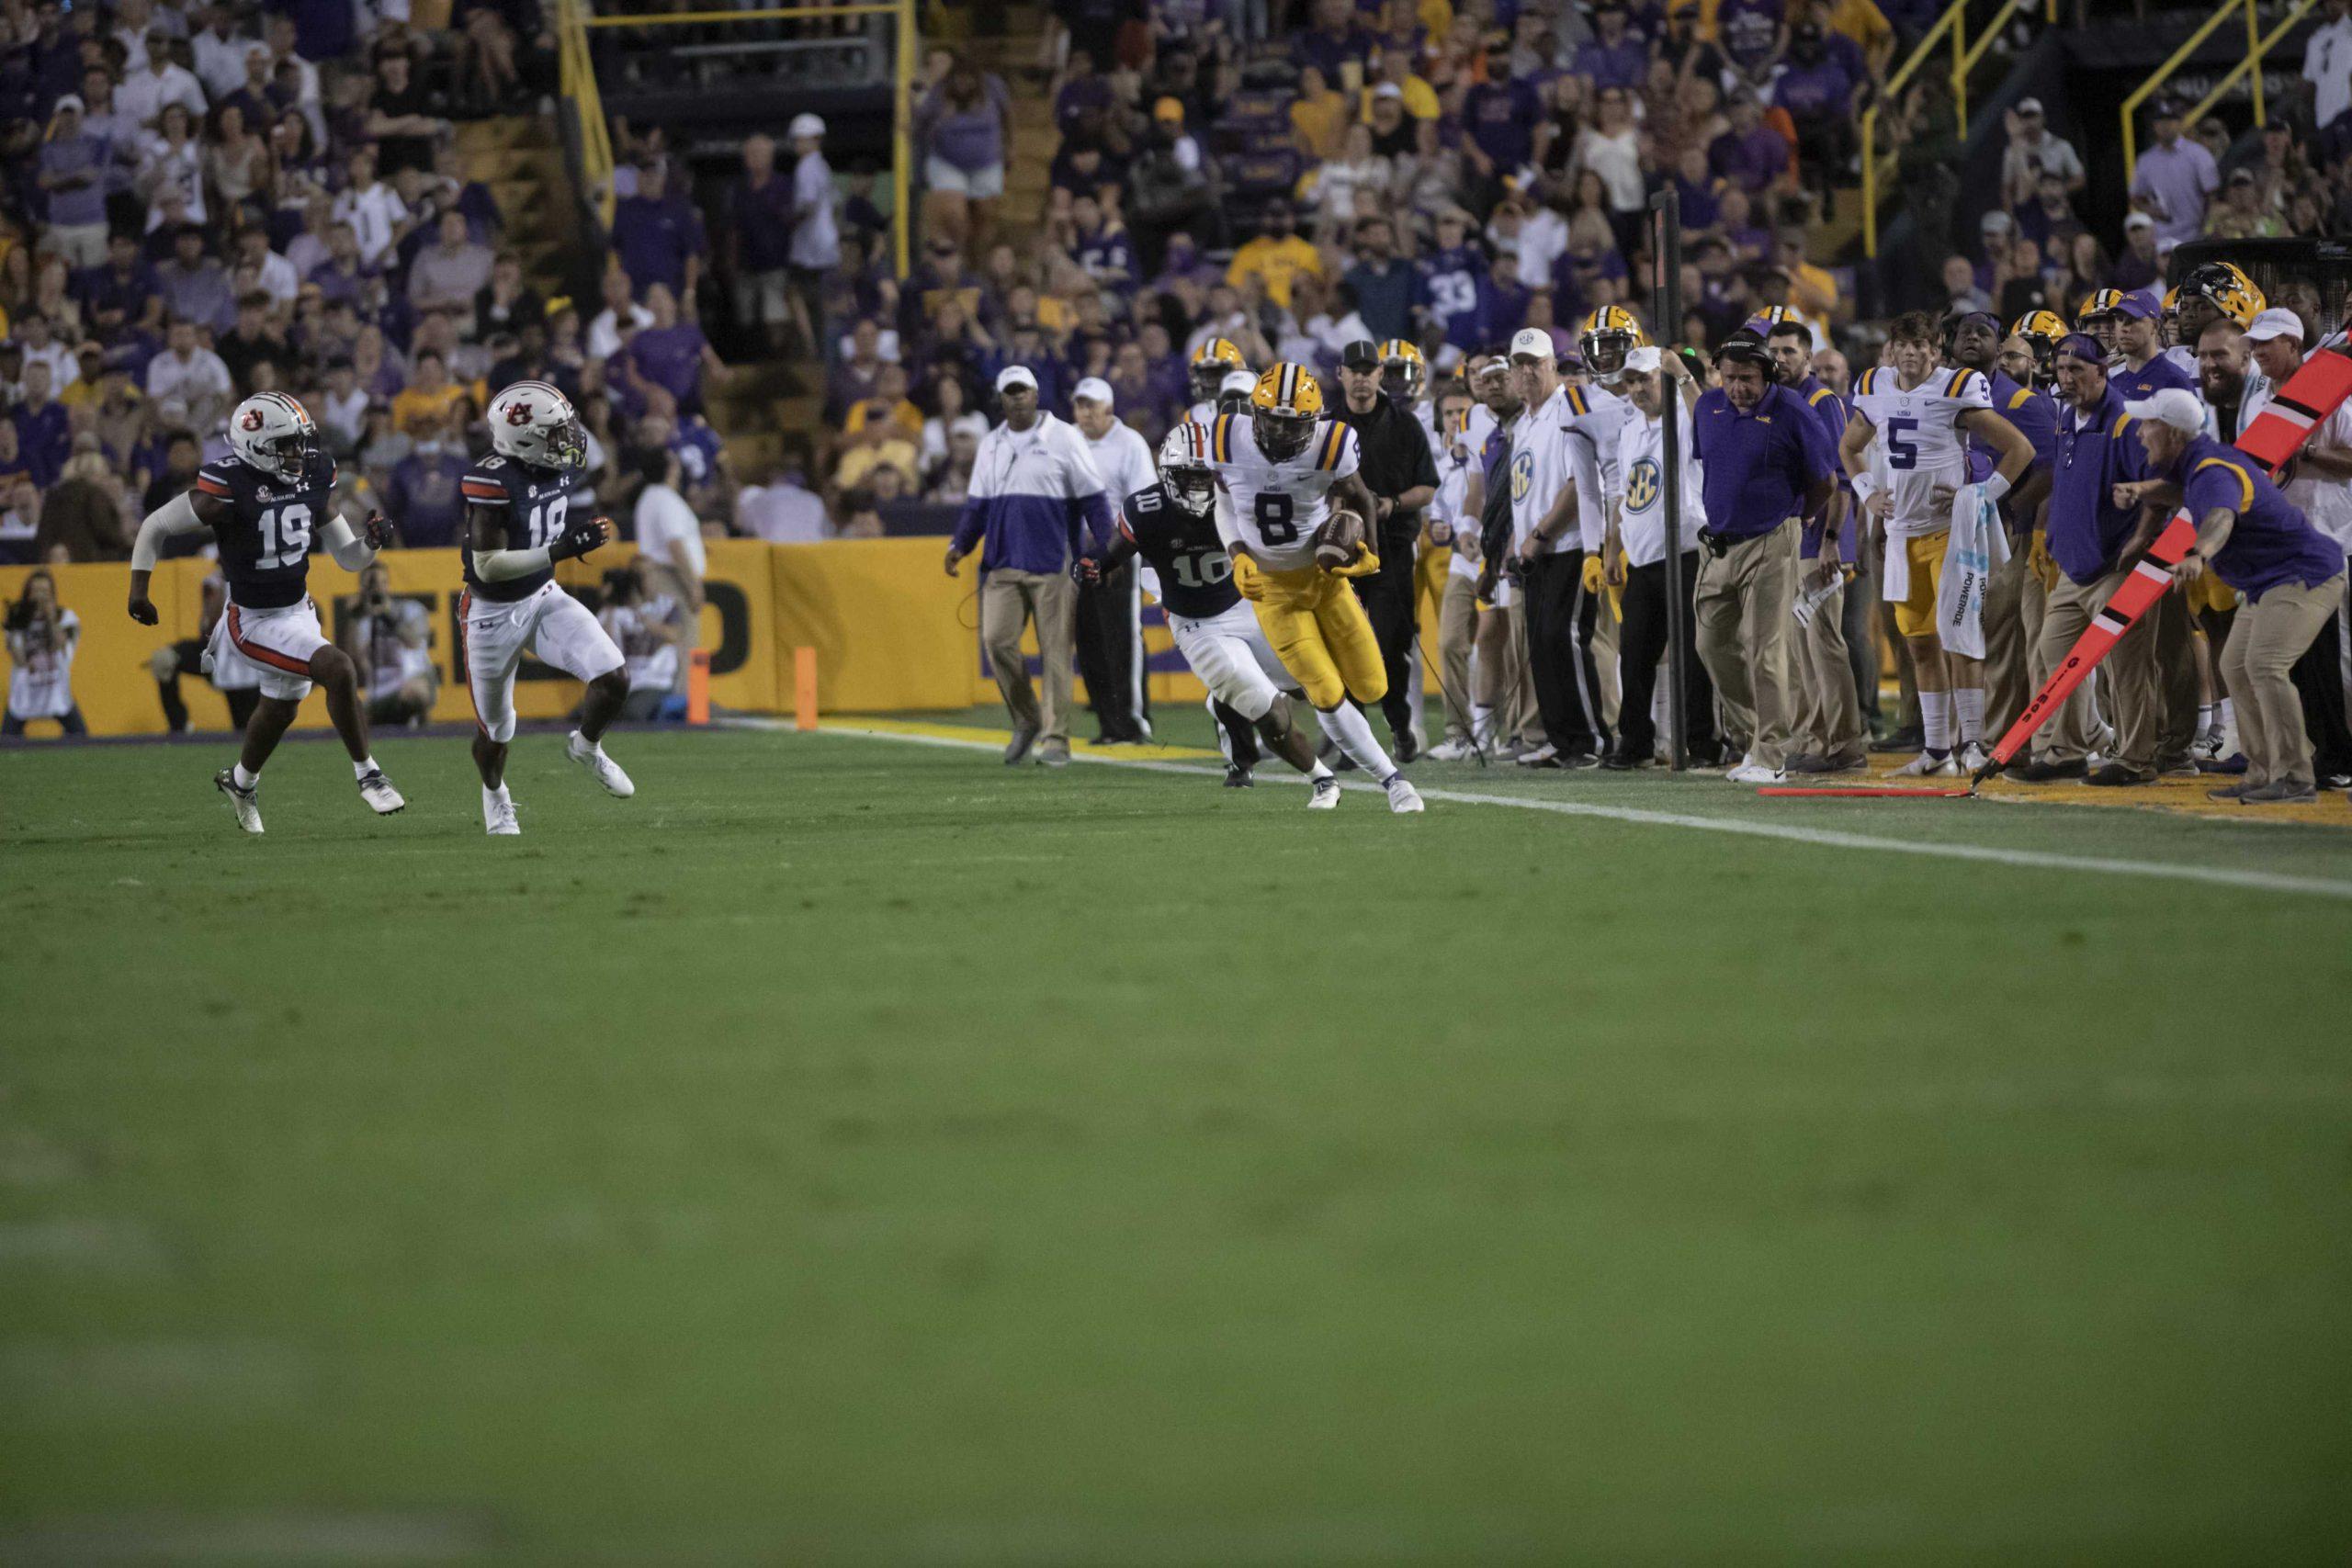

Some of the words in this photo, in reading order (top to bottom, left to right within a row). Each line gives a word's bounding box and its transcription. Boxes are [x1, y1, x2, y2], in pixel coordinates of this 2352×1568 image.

[1888, 417, 1918, 469] 5
[1135, 491, 1162, 513] 10
[1255, 492, 1297, 546] 8
[255, 503, 311, 570] 19
[1172, 551, 1232, 587] 10
[1952, 571, 1974, 626] POWERADE
